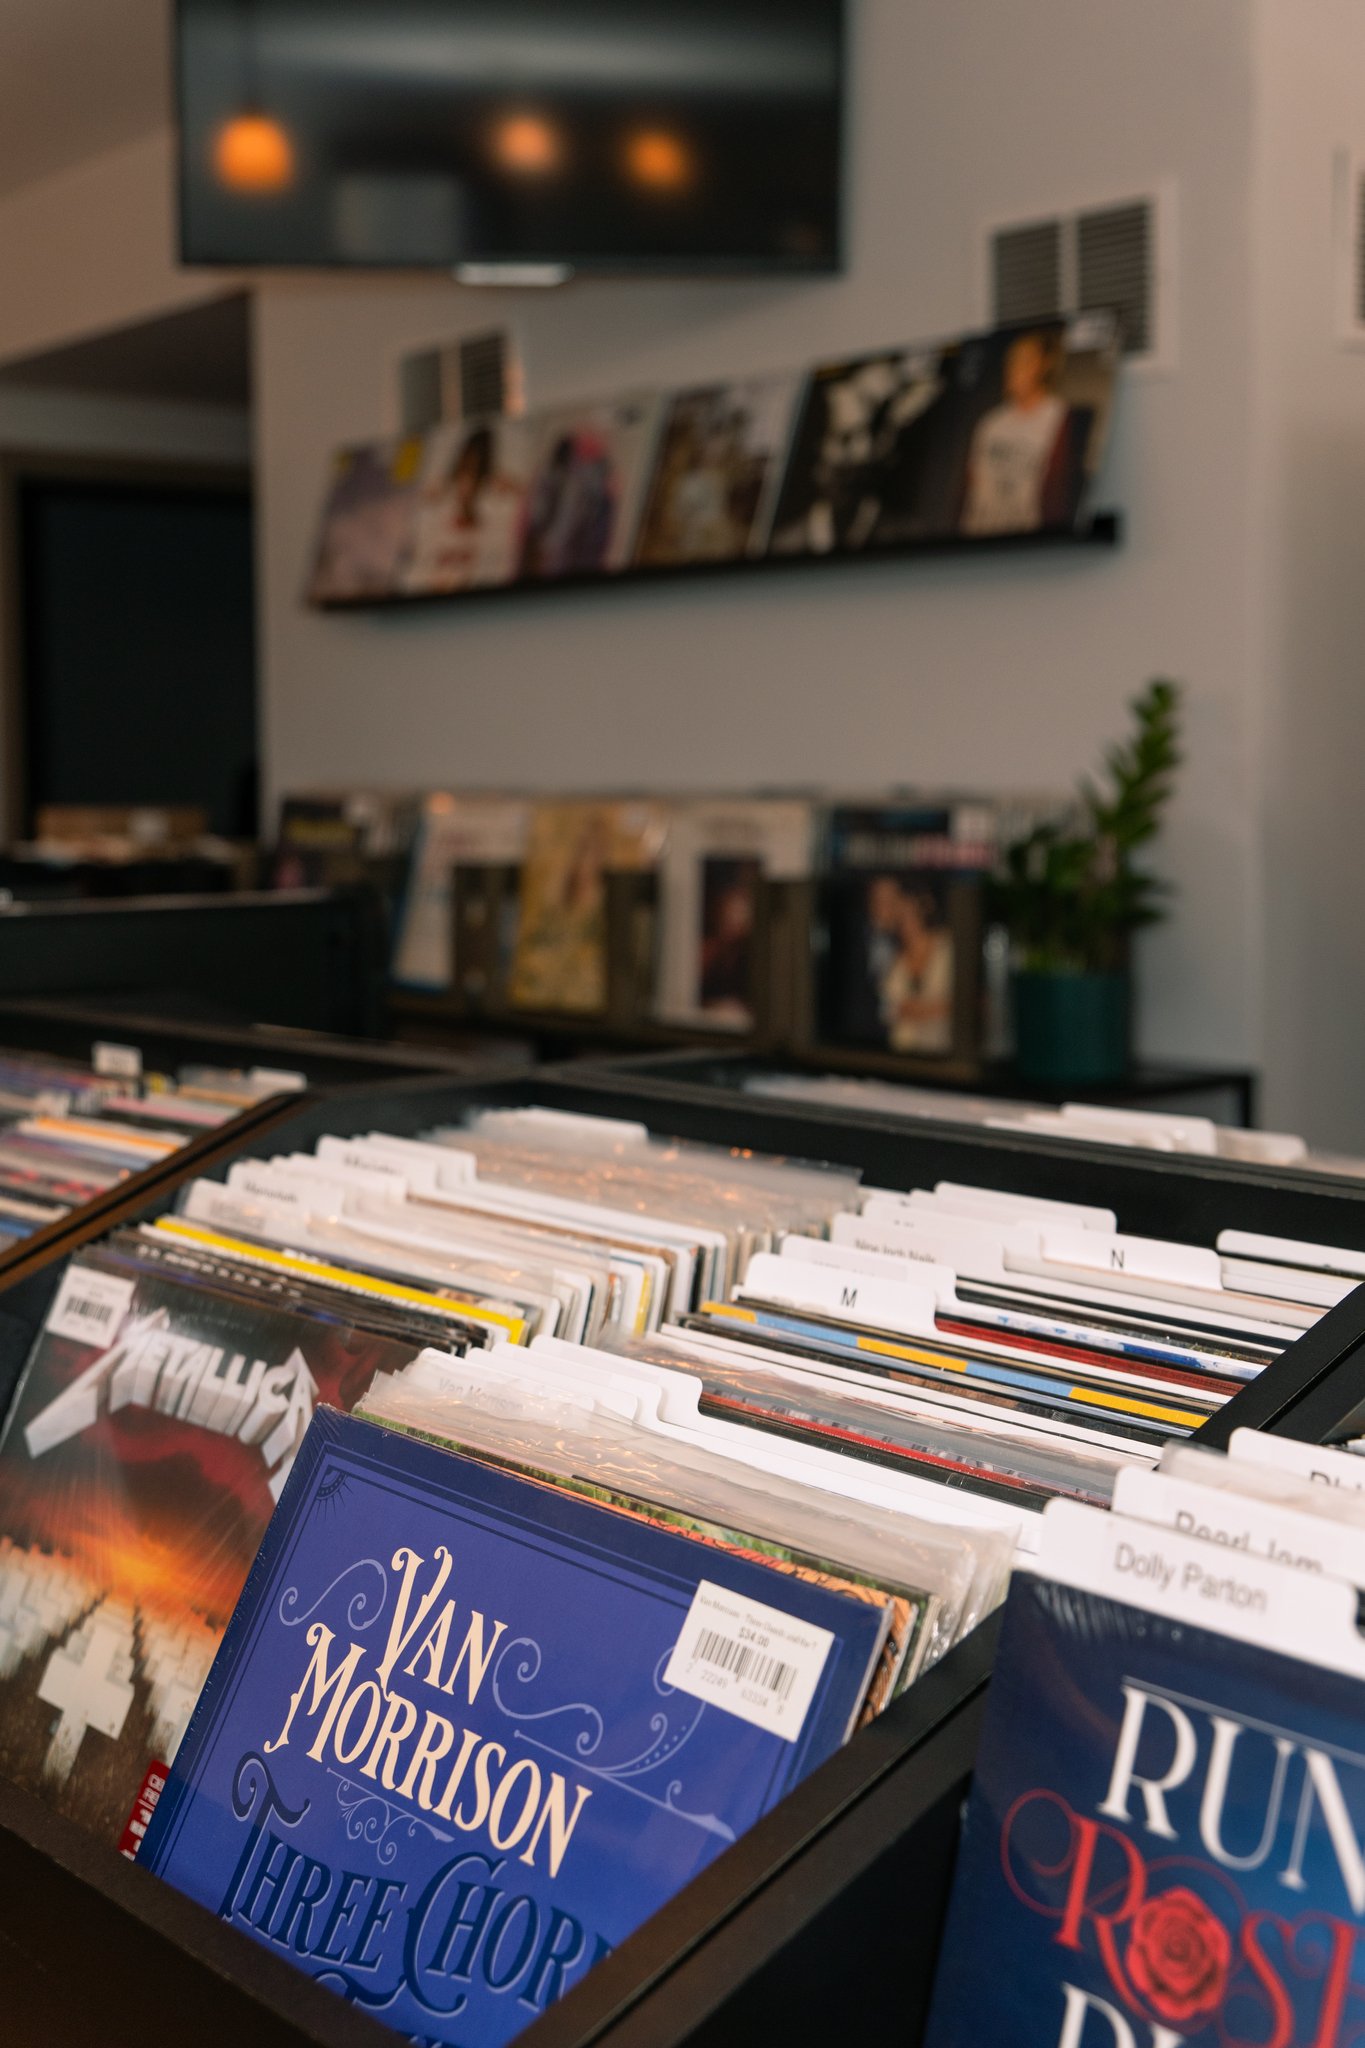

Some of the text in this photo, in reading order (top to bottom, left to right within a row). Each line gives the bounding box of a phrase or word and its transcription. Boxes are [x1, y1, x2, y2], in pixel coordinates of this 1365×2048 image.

[840, 1286, 858, 1308] M
[1111, 1248, 1125, 1269] N
[25, 1307, 319, 1504] METALLICA
[375, 1545, 509, 1705] VAN
[1113, 1541, 1268, 1615] Dolly Parton
[263, 1621, 593, 1880] MORRISON
[1096, 1685, 1365, 1918] RUN
[218, 1751, 409, 1972] THREE
[402, 1851, 617, 2017] CHOR
